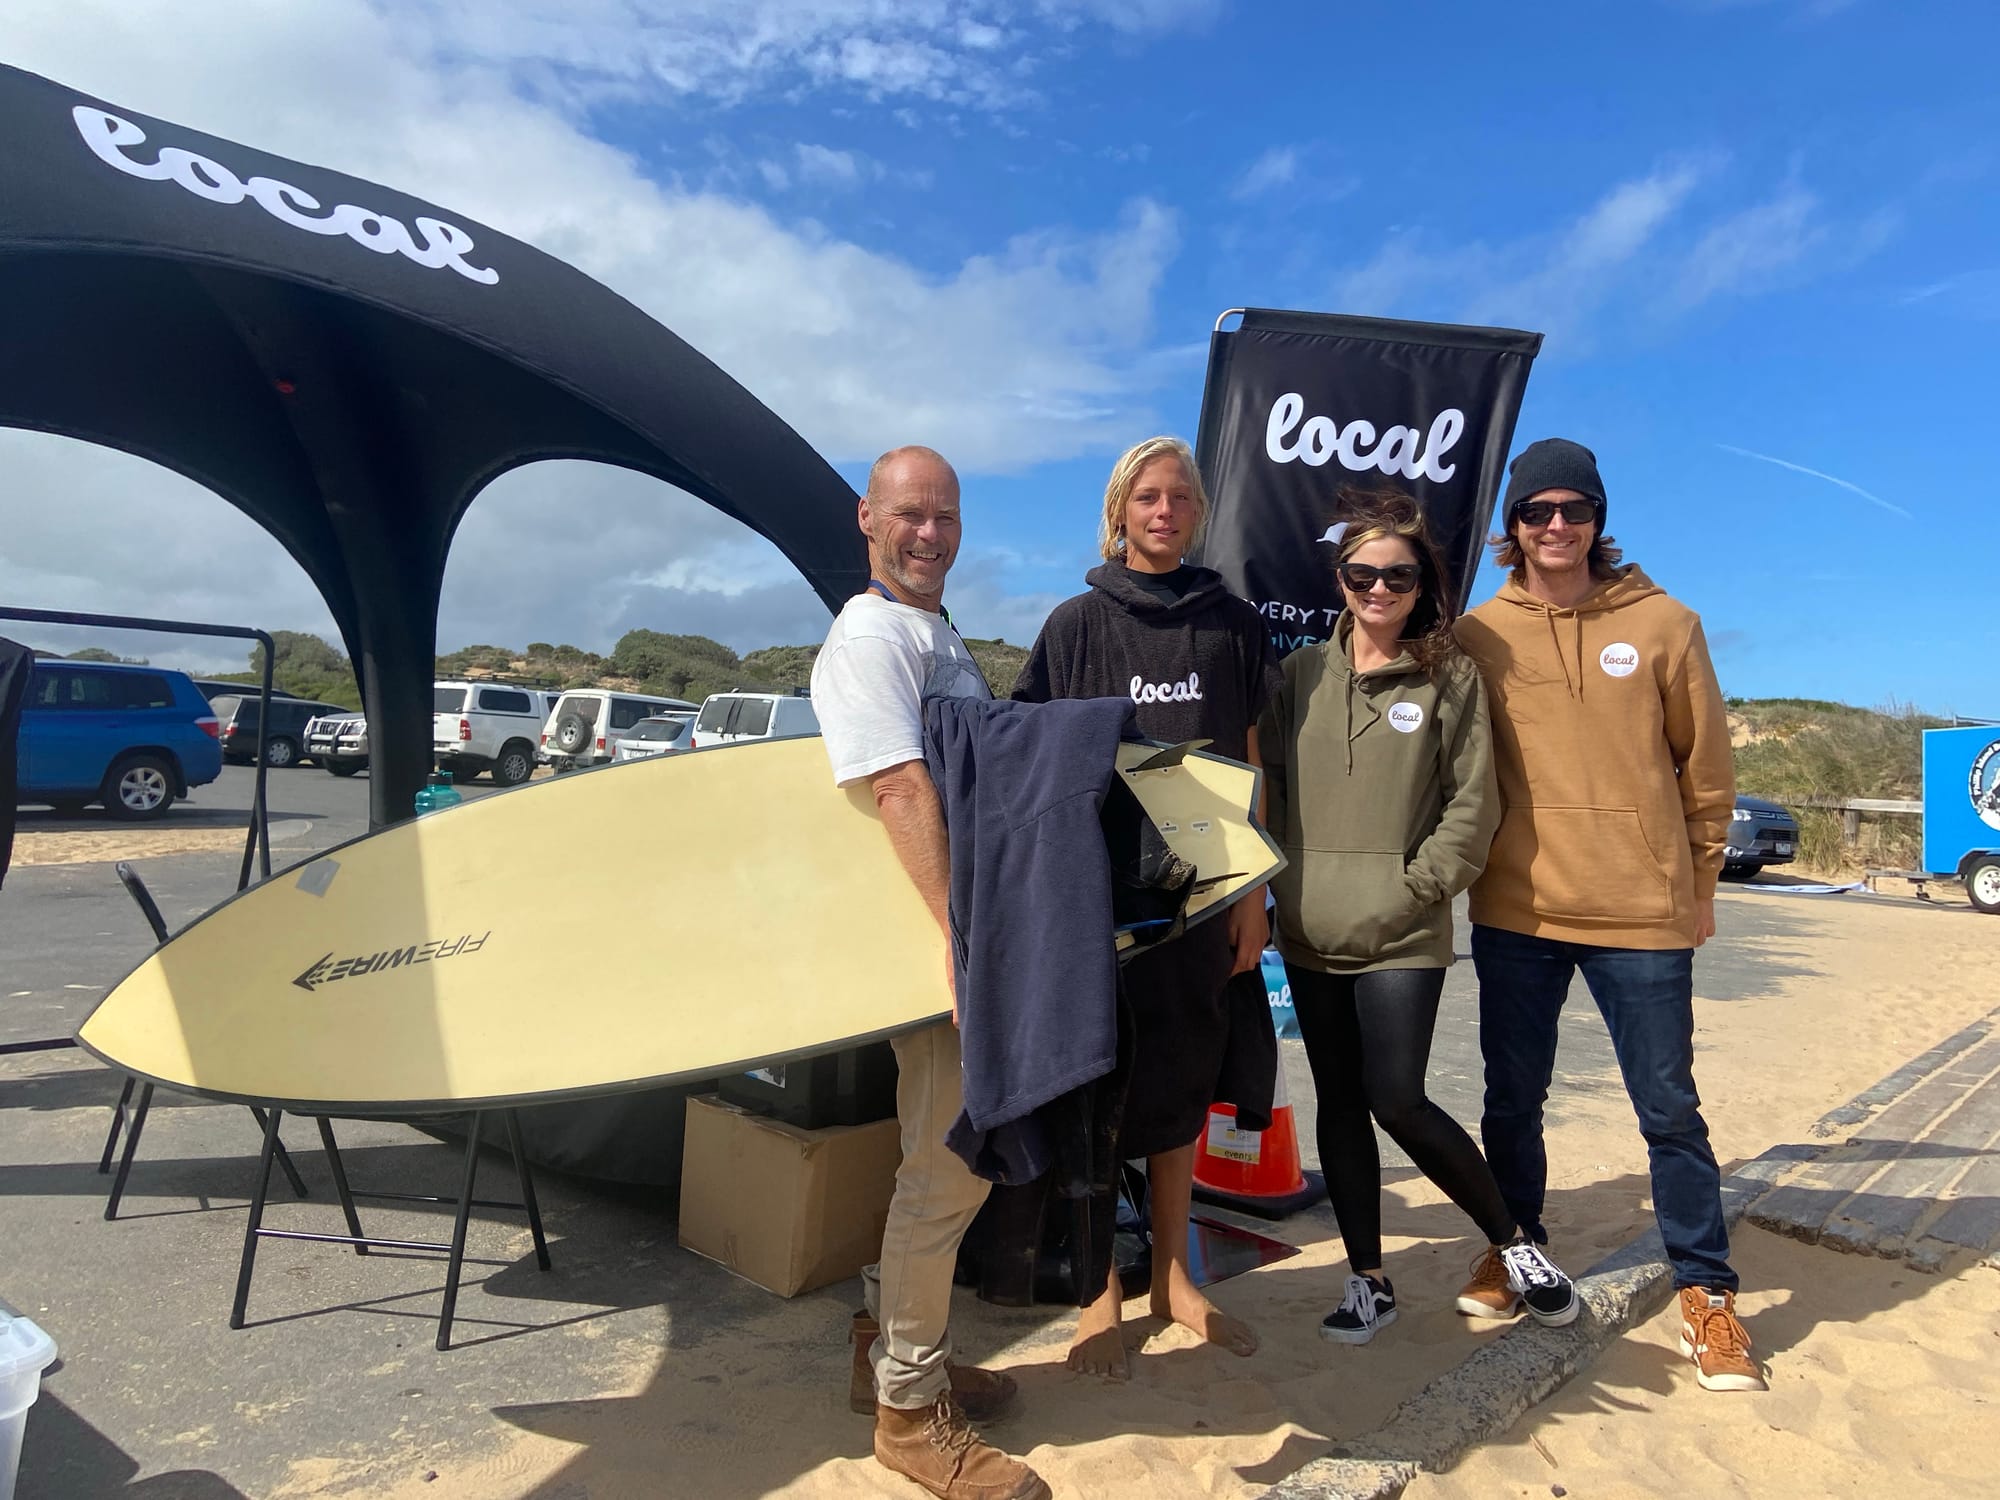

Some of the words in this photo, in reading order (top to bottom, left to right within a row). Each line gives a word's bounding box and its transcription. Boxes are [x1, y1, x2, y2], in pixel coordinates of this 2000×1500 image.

[72, 105, 500, 285] local
[1265, 392, 1465, 484] local
[1243, 598, 1315, 625] VERY
[1603, 653, 1635, 666] local
[1130, 671, 1203, 705] local
[1392, 710, 1420, 722] local
[326, 930, 491, 983] FIREWIRE
[1224, 1150, 1252, 1161] events
